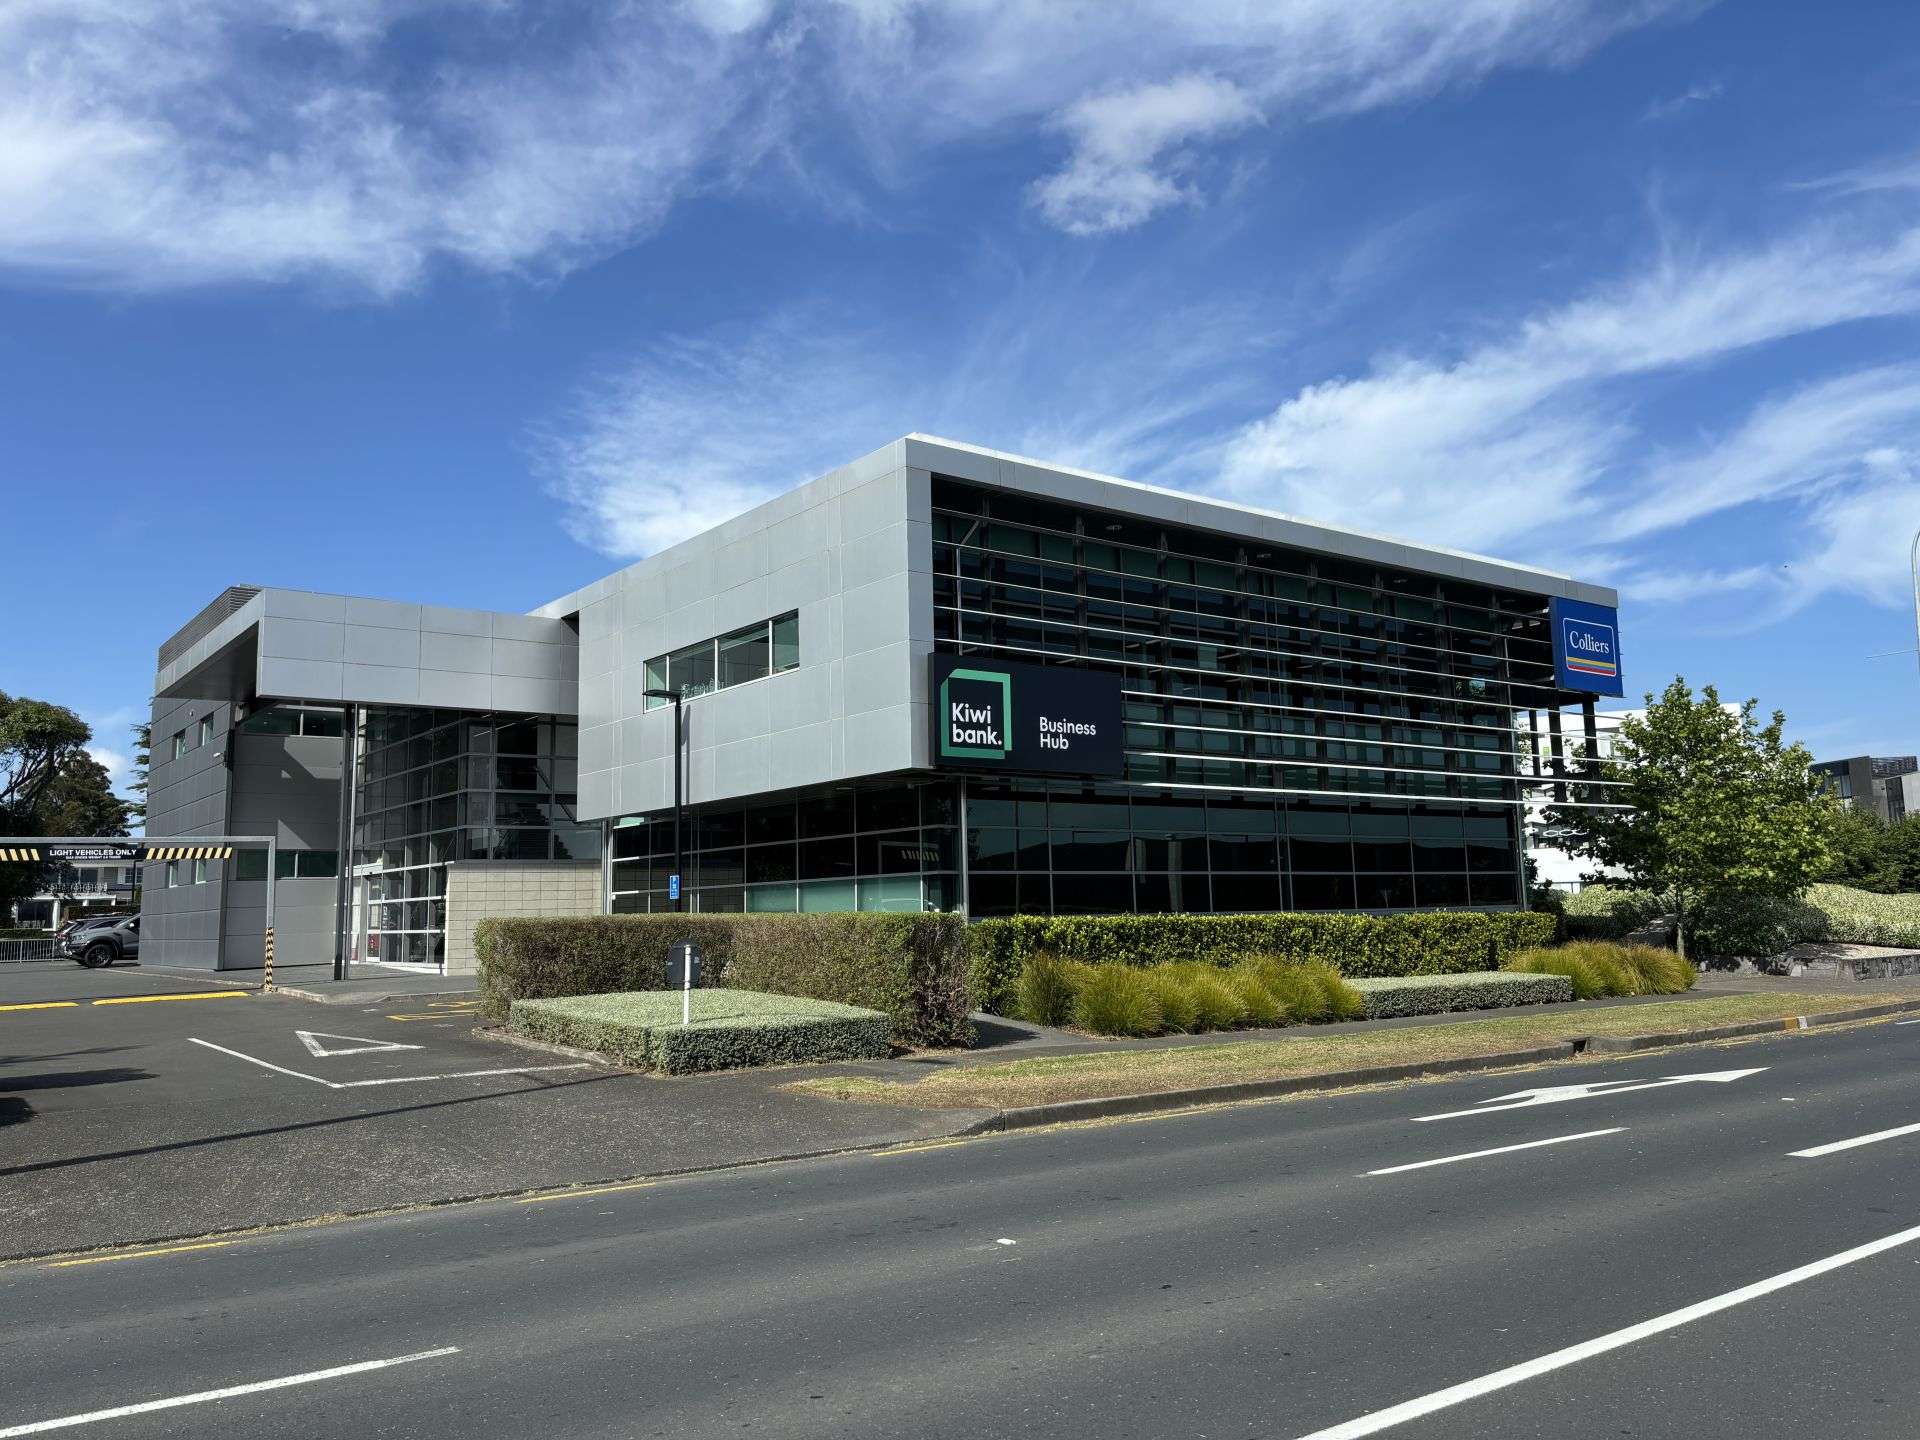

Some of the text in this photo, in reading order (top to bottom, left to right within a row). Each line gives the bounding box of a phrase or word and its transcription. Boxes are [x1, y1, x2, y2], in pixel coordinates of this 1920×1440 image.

[1569, 630, 1609, 654] Colliers
[952, 702, 991, 724] Kiwi
[952, 723, 1003, 745] bank.
[1039, 716, 1097, 736] Business
[1040, 733, 1069, 750] Hub
